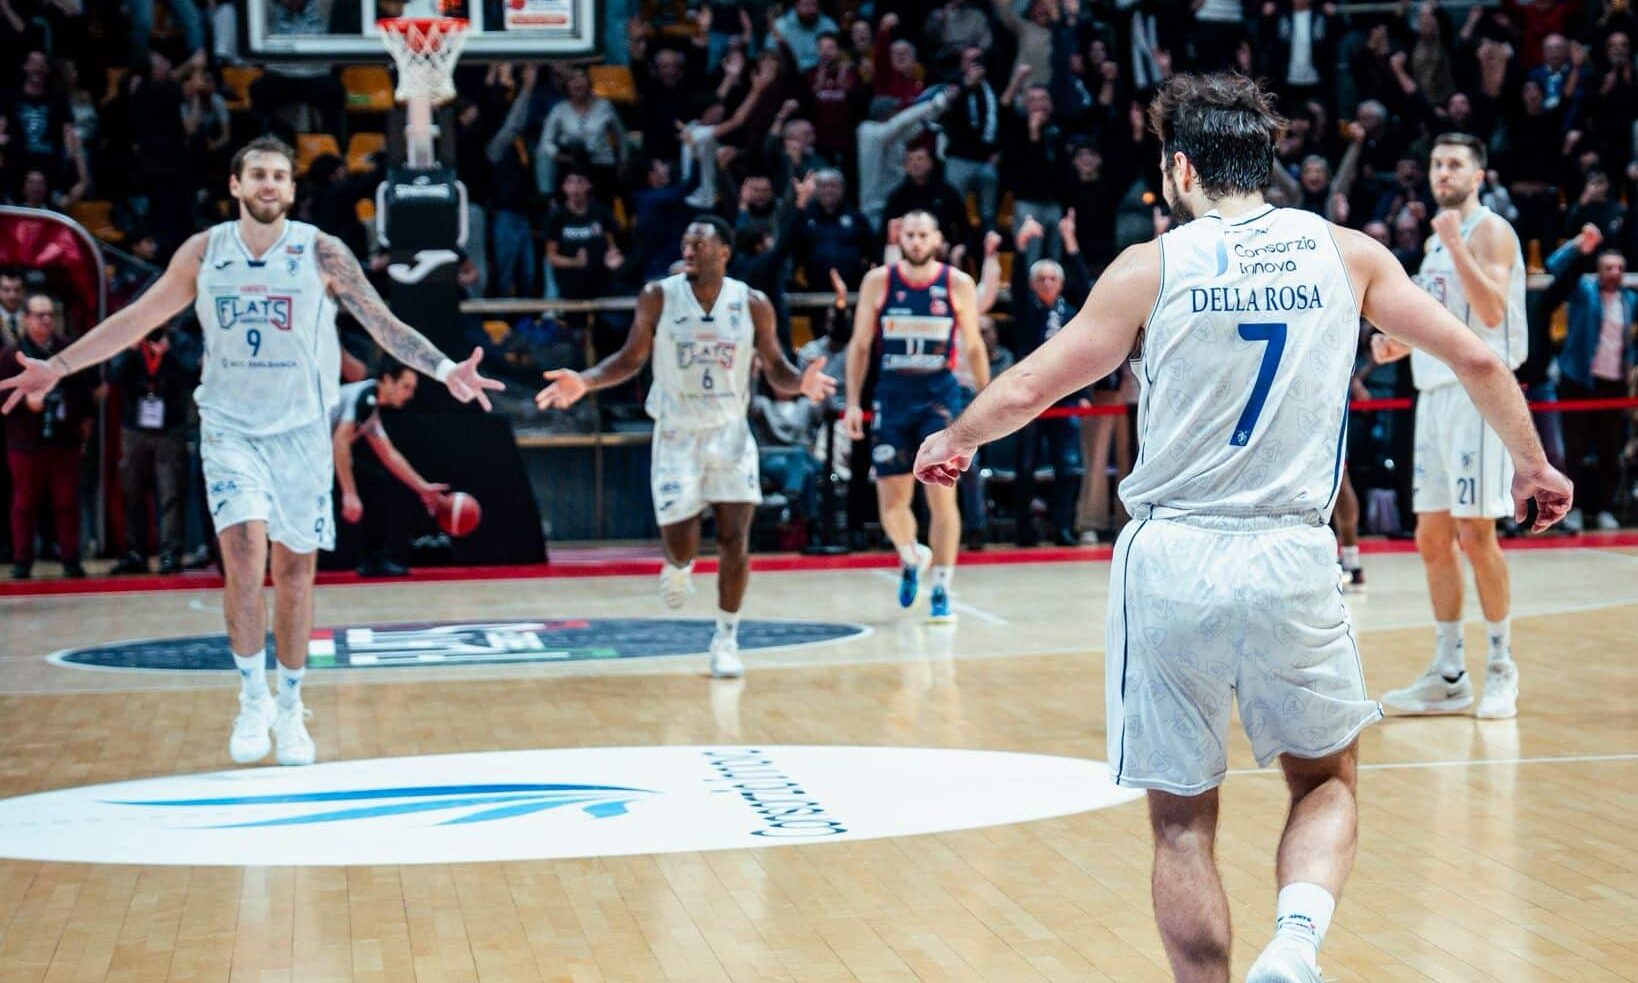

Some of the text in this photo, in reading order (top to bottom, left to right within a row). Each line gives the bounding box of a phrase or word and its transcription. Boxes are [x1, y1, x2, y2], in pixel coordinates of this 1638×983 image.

[1234, 236, 1317, 258] Consorzio
[220, 299, 288, 325] FLATS
[1190, 284, 1323, 313] DELLA ROSA
[246, 329, 262, 357] 9
[703, 367, 714, 390] 6
[1229, 323, 1287, 447] 7
[1456, 477, 1475, 505] 21
